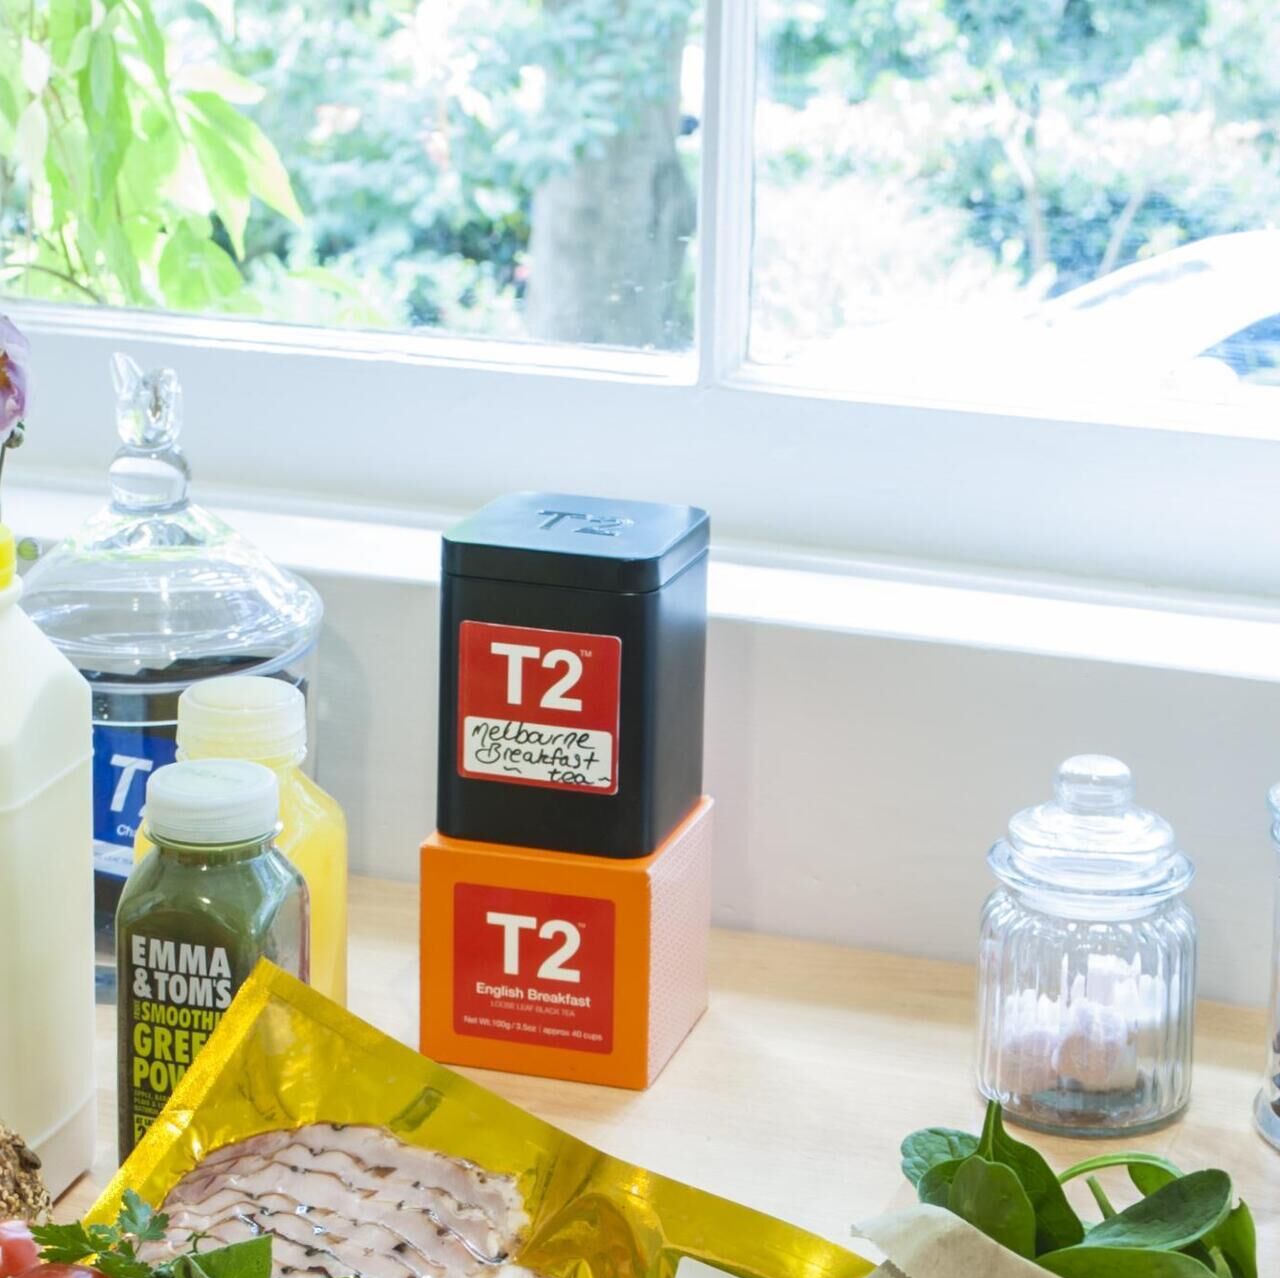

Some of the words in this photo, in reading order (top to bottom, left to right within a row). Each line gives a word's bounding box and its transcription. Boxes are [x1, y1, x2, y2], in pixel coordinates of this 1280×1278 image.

[537, 509, 622, 537] T2
[490, 641, 584, 712] T2
[475, 743, 599, 769] Breakfast
[110, 753, 154, 817] T
[132, 934, 232, 978] EMMA
[486, 911, 581, 983] T2
[133, 967, 152, 999] &
[153, 971, 232, 1009] TOM'S
[475, 981, 523, 999] English
[527, 988, 591, 1008] Breakfast
[142, 1001, 225, 1031] SMOOTHI
[490, 1000, 515, 1010] LOOSE
[516, 1003, 533, 1012] LEAF
[535, 1005, 559, 1015] BLACK
[561, 1008, 576, 1017] TEA
[133, 1022, 213, 1064] GREE
[571, 1029, 582, 1039] 40
[583, 1032, 603, 1042] cups
